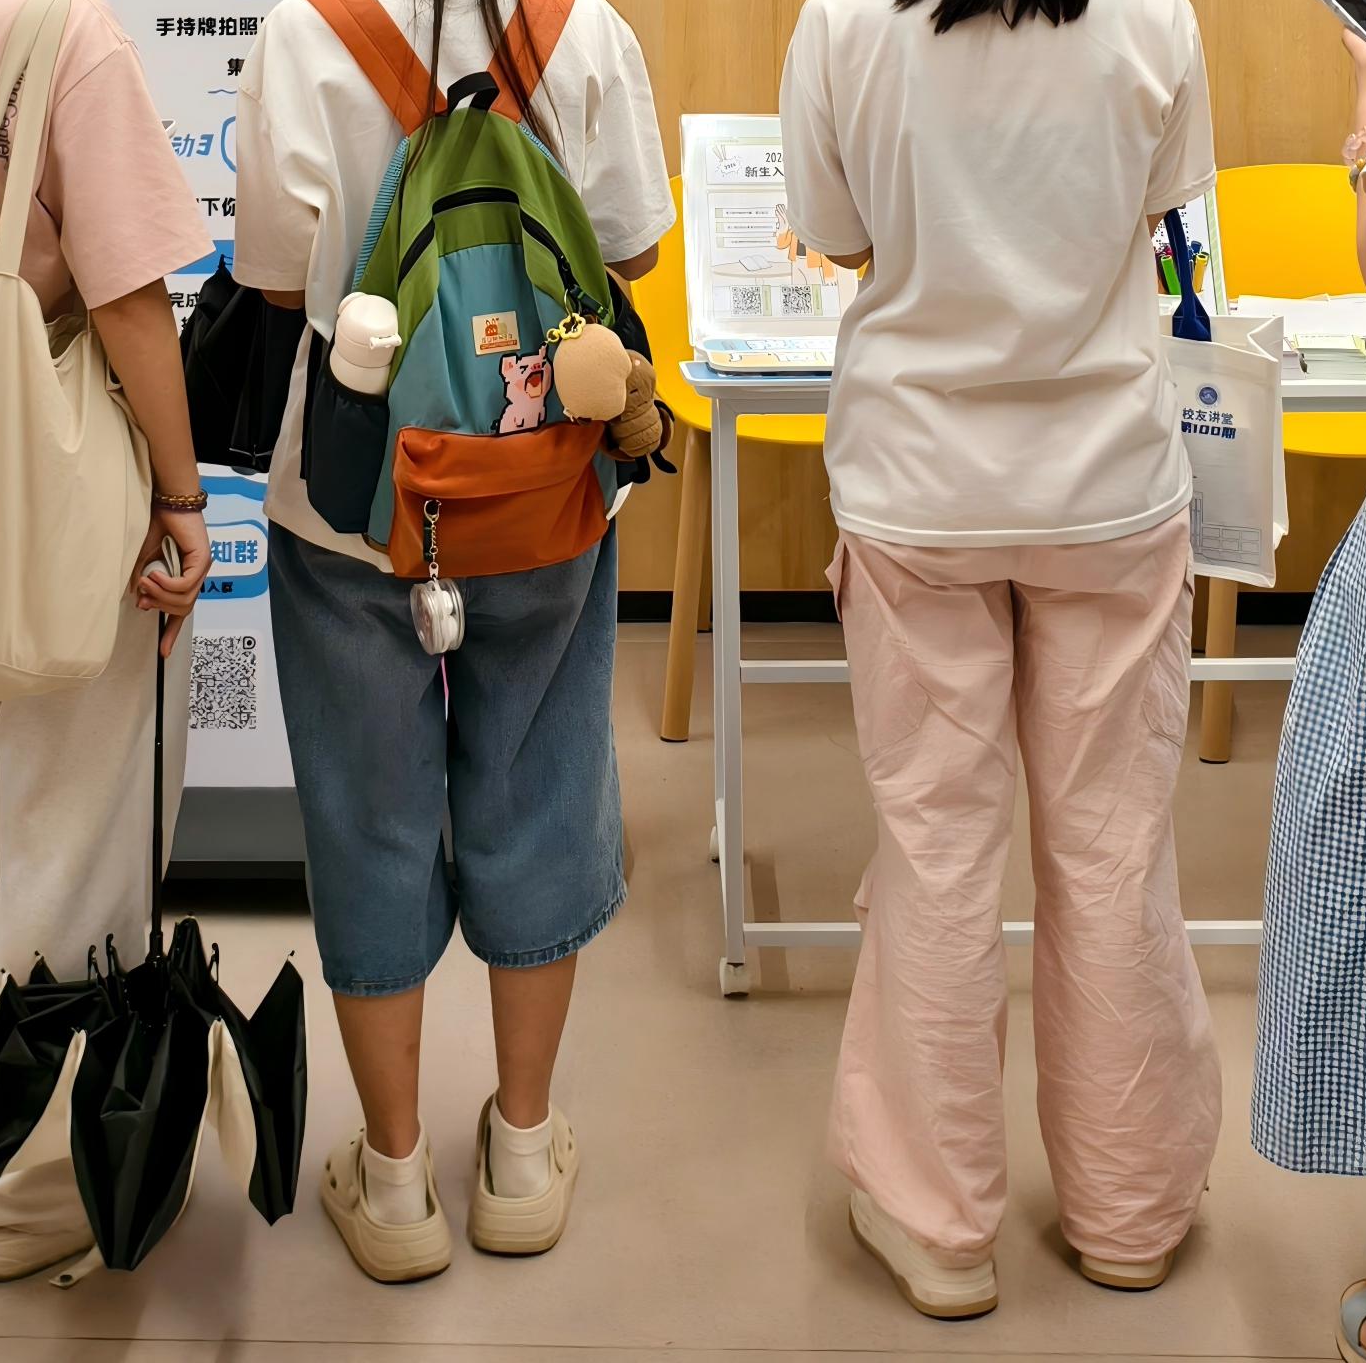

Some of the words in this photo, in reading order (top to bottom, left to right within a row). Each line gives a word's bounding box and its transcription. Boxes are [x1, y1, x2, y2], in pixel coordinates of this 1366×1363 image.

[156, 17, 265, 36] 手持牌拍照
[1182, 407, 1234, 425] 校友讲堂
